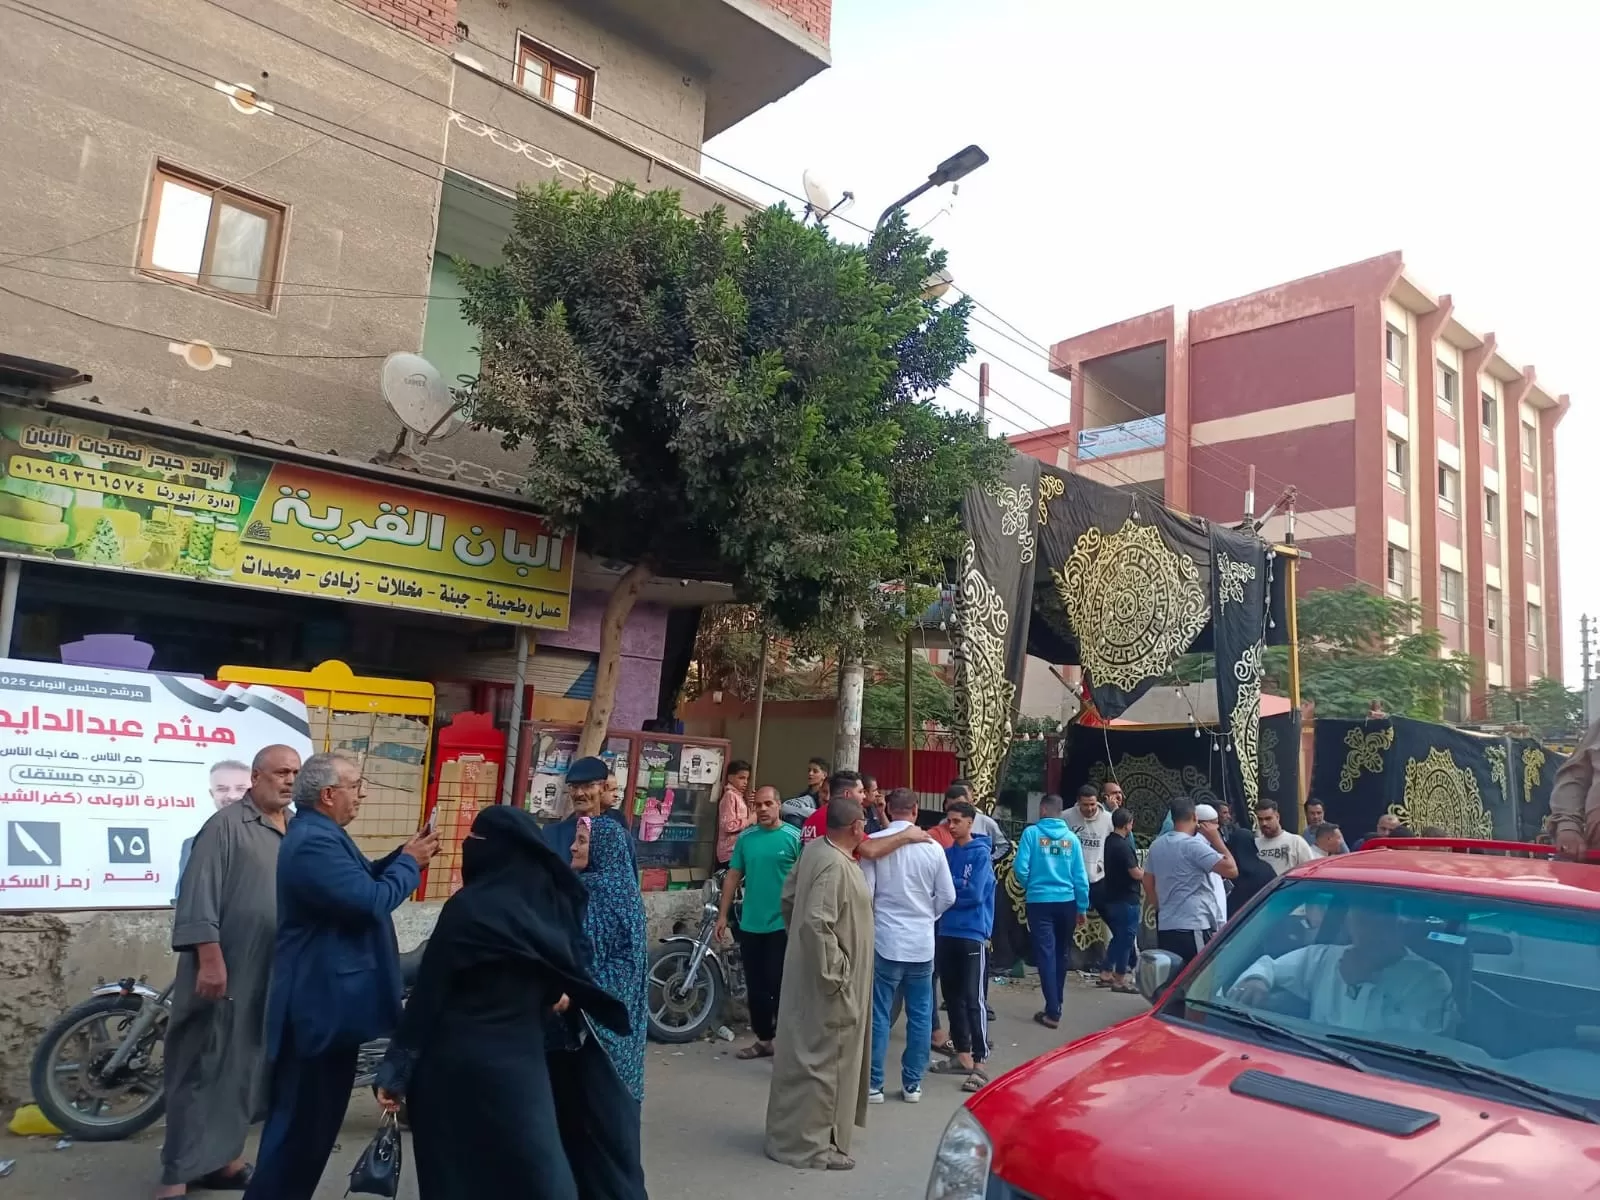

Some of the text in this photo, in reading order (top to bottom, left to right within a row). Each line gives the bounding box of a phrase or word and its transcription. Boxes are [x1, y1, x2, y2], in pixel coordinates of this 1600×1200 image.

[25, 426, 225, 480] أولاد حيدر لمنتجات الألبان
[16, 462, 145, 494] ٠١٠٩٩٣٦٦٥٧٤
[271, 484, 447, 551] القرية
[241, 555, 301, 584] مجمدات
[377, 575, 423, 598] مخللات
[439, 584, 471, 609] جبنة
[486, 590, 534, 618] وطحينة
[535, 601, 561, 619] عسل
[0, 676, 144, 698] مرشح مجلس النواب 025
[153, 714, 236, 748] هيثم
[0, 746, 32, 757] الناس
[60, 749, 79, 760] من
[90, 751, 121, 762] الناس
[123, 755, 143, 764] مع
[18, 767, 137, 786] فردي مستقل
[113, 835, 146, 856] ١٥
[0, 874, 90, 891] رمز السكي
